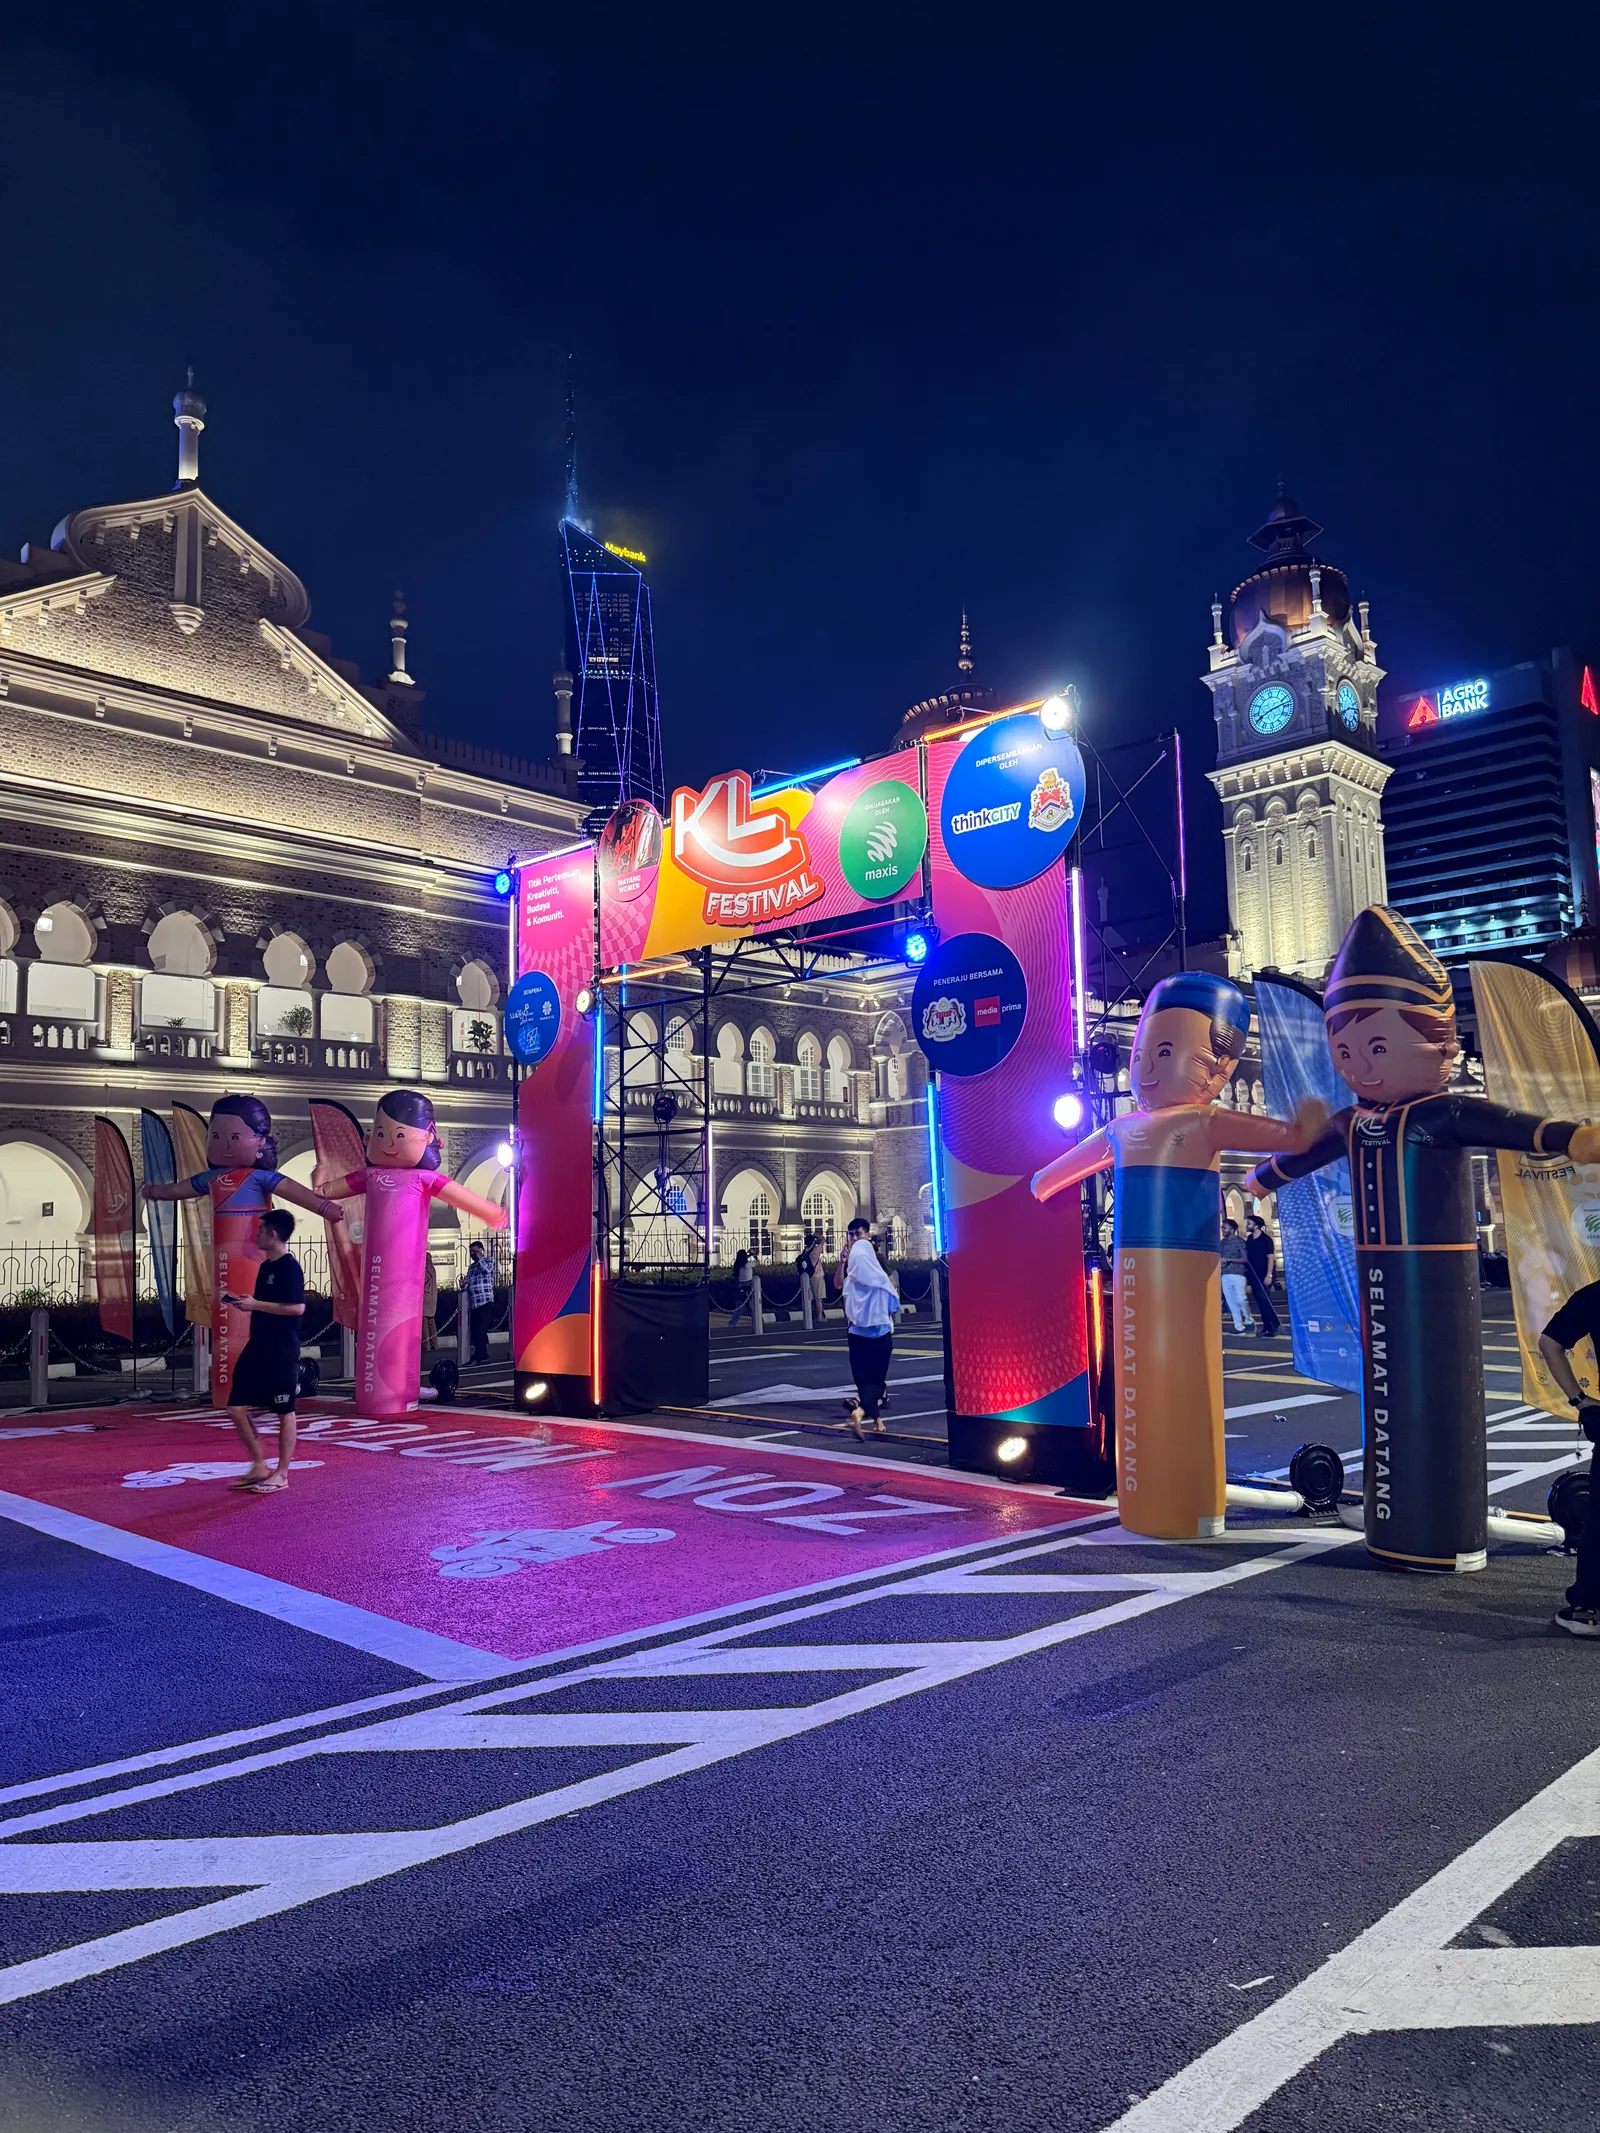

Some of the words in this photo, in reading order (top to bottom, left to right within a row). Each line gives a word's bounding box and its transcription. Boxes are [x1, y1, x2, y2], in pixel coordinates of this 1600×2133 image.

[605, 542, 646, 562] Maybank
[1441, 681, 1488, 704] AGRO
[1441, 694, 1489, 718] BANK
[975, 742, 1043, 768] DIPERSEMBAHKAN
[999, 759, 1019, 770] OLEH
[864, 796, 901, 811] DIKUASAKAN
[874, 807, 890, 816] OLEH
[674, 775, 796, 872] KL
[952, 804, 1020, 832] thinkCITY
[527, 877, 542, 889] Titik
[543, 868, 581, 885] Pertemuan
[617, 874, 641, 886] WAYANG
[865, 863, 899, 881] maxis
[526, 885, 560, 902] Kreativiti,
[618, 883, 640, 894] WOMEN
[706, 871, 820, 918] FESTIVAL
[526, 902, 551, 915] Budaya
[526, 917, 532, 927] &
[533, 909, 565, 925] Komuniti.
[933, 974, 968, 987] PENERAJU
[969, 968, 1004, 980] BERSAMA
[976, 1006, 998, 1016] media
[1001, 1003, 1022, 1014] prima
[1356, 1116, 1386, 1137] KL
[1361, 1139, 1392, 1147] FESTIVAL
[217, 1174, 235, 1186] KL
[376, 1174, 396, 1187] KL
[367, 1255, 382, 1326] SELAMAT
[1123, 1257, 1137, 1375] SELAMAT
[1368, 1267, 1388, 1397] SELAMAT
[219, 1325, 228, 1383] DATANG
[364, 1332, 376, 1393] DATANG
[1123, 1387, 1138, 1492] DATANG
[1373, 1408, 1392, 1521] DATANG
[593, 1464, 971, 1536] ZON
